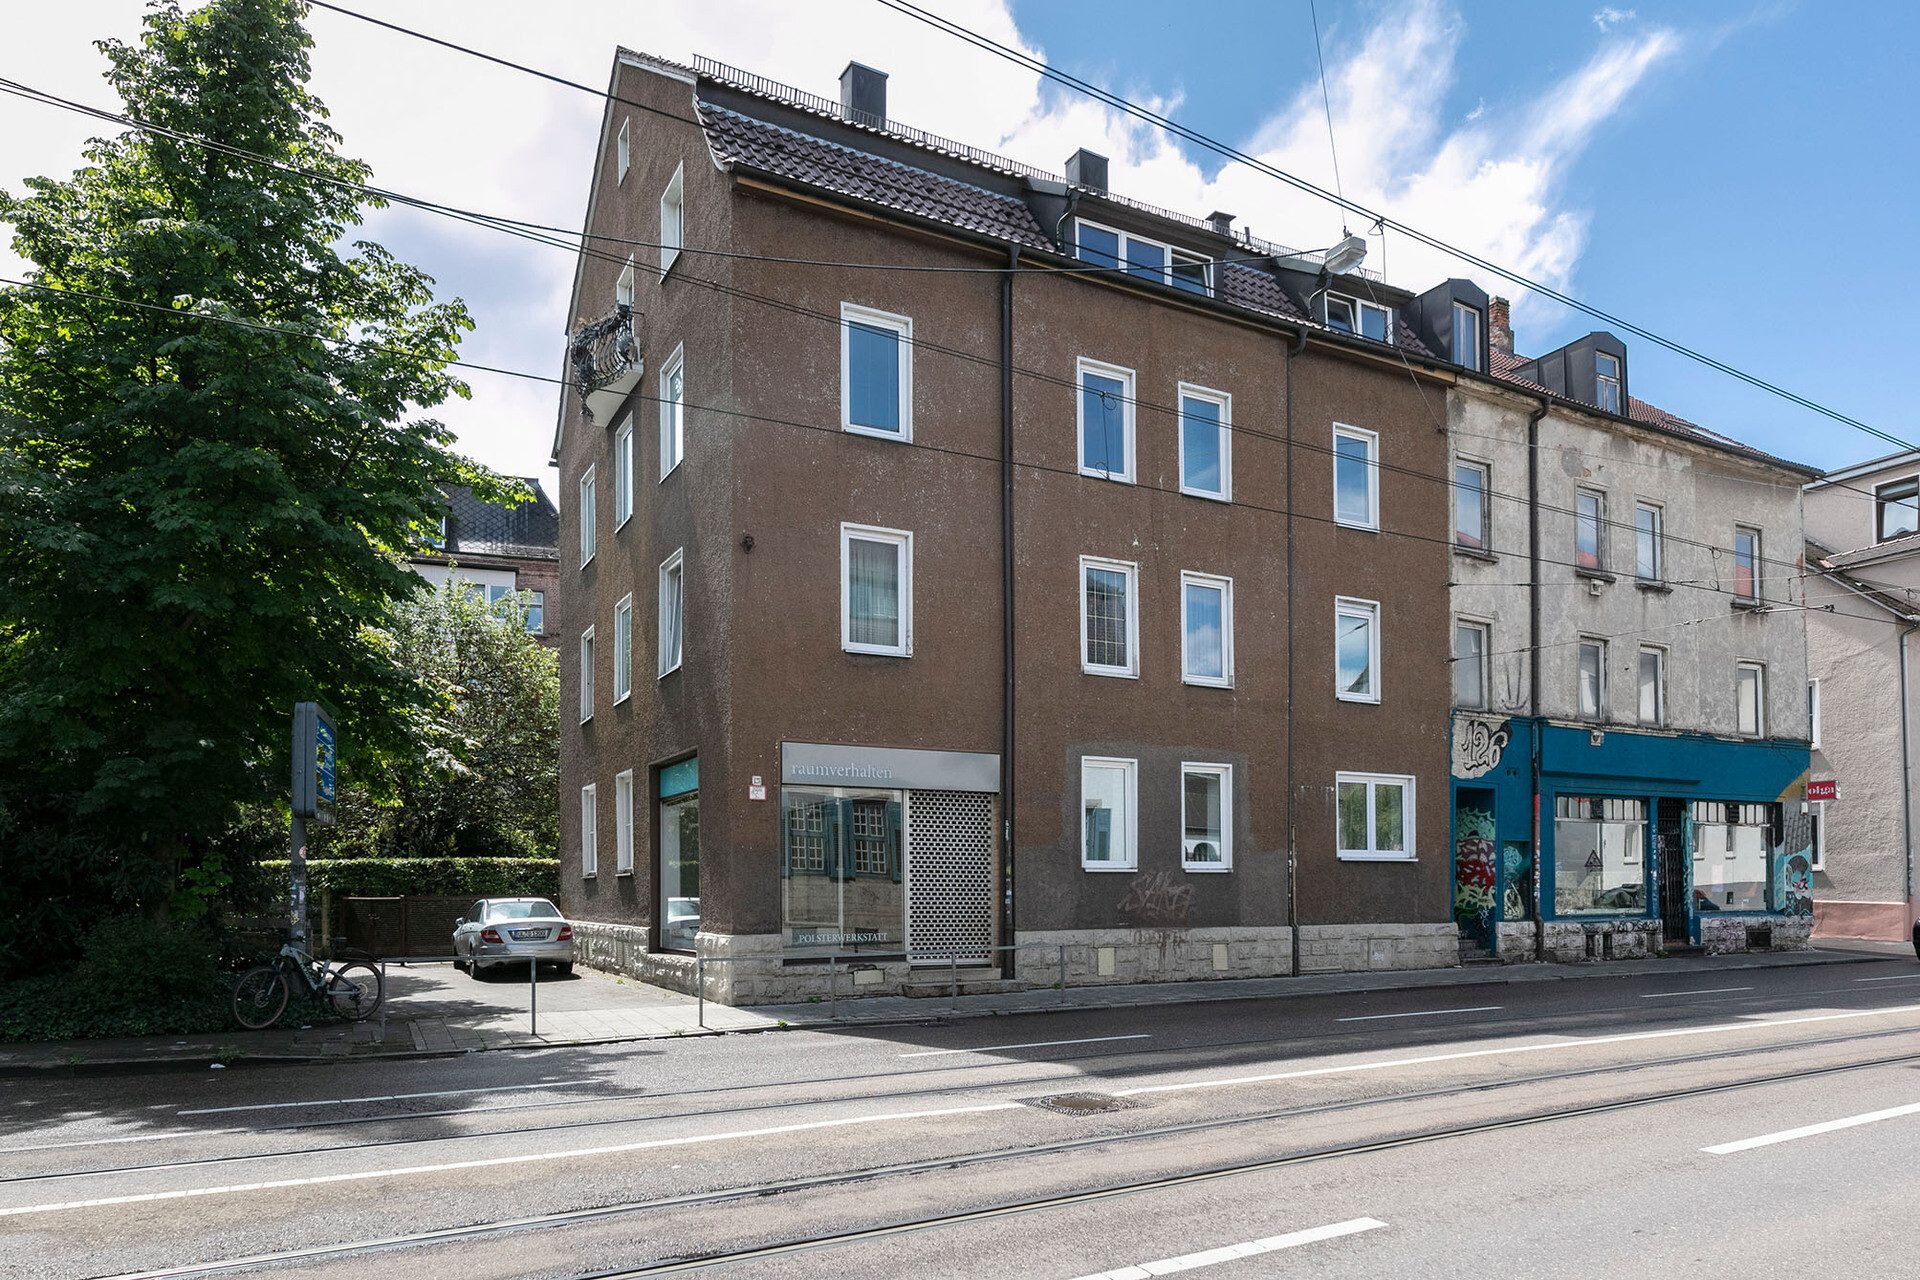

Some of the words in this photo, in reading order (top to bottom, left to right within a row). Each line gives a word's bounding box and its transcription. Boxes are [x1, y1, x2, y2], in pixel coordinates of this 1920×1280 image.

[1461, 720, 1509, 770] 126
[791, 762, 893, 779] raumverhalten
[799, 932, 888, 943] POLSTERWERKSTATT
